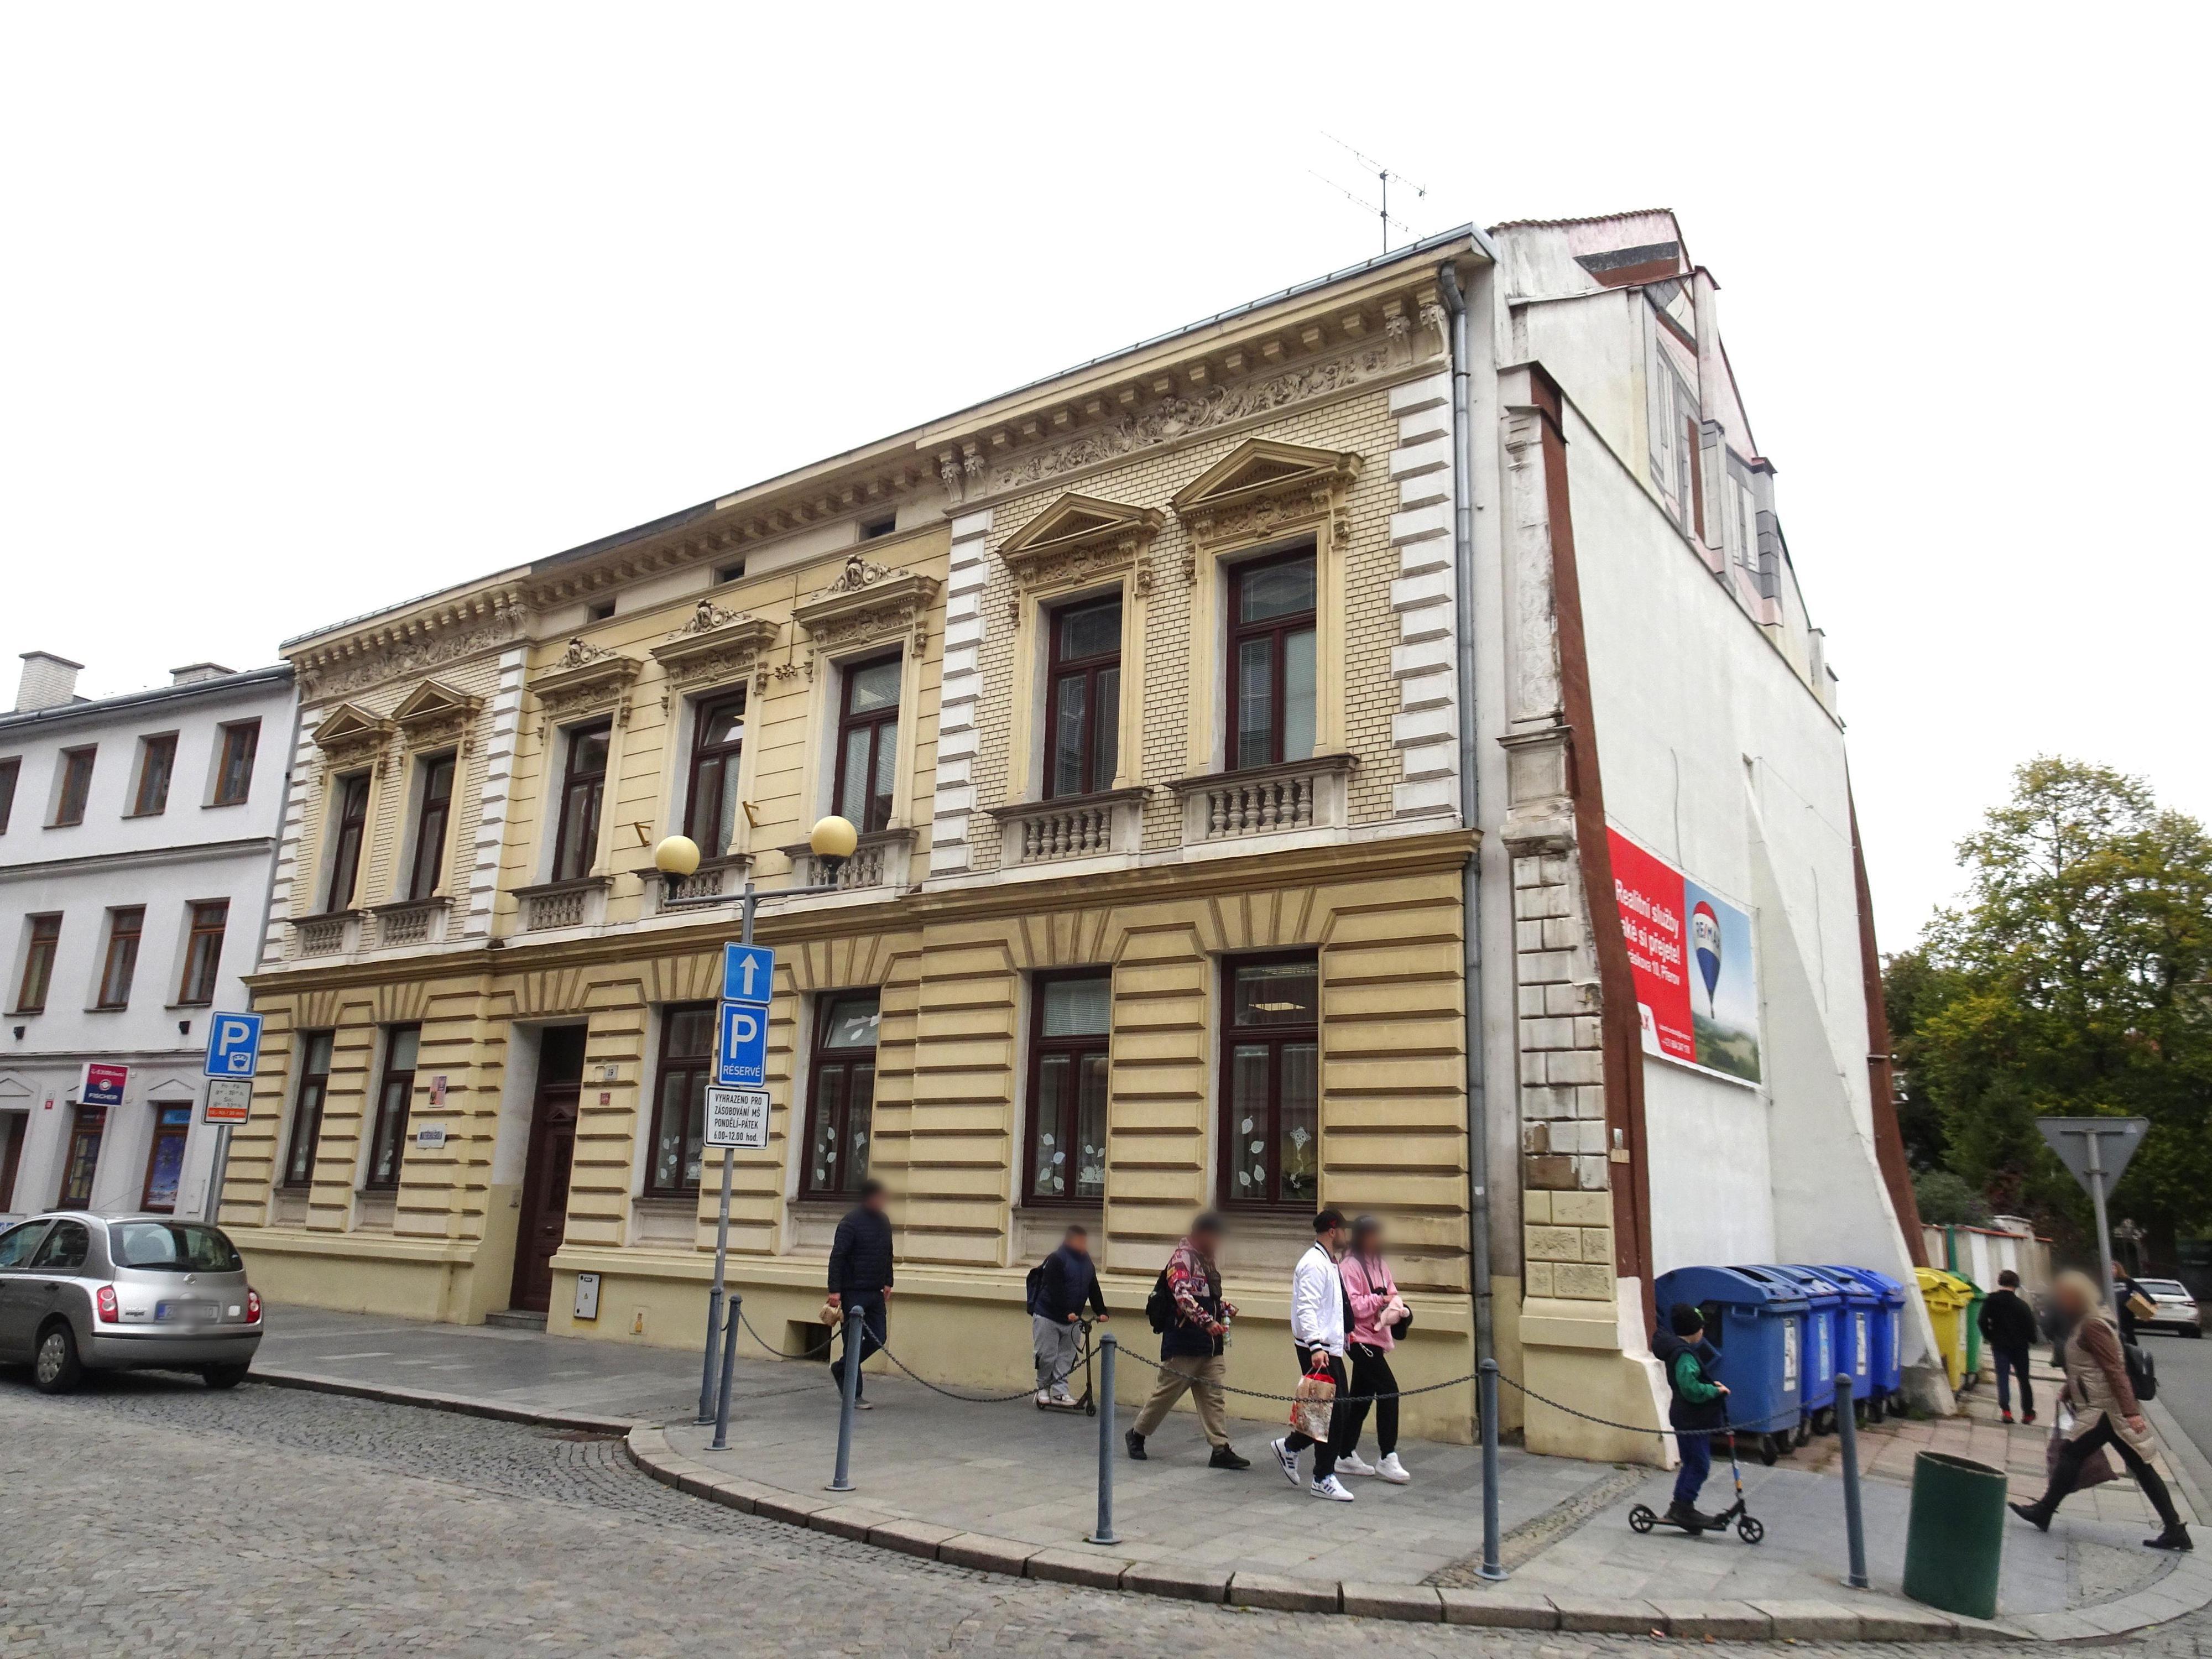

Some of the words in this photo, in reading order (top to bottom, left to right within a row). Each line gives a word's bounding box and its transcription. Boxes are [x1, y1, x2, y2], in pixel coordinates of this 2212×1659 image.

[1615, 878, 1651, 919] Realitní
[1651, 904, 1679, 939] služby
[1621, 916, 1637, 942] aké
[1639, 926, 1648, 948] si
[1648, 932, 1681, 965] přejete!
[219, 1021, 250, 1056] P
[731, 1014, 757, 1059] P
[723, 1063, 761, 1077] RÉSERVÉ
[715, 1093, 748, 1104] VYHRAZENO
[751, 1096, 762, 1105] PRO
[714, 1104, 750, 1117] ZÁSOBOVÁNÍ
[752, 1107, 760, 1118] MŠ
[714, 1117, 759, 1129] PONDĚLÍ-PÁTEK
[745, 1133, 758, 1141] hod.
